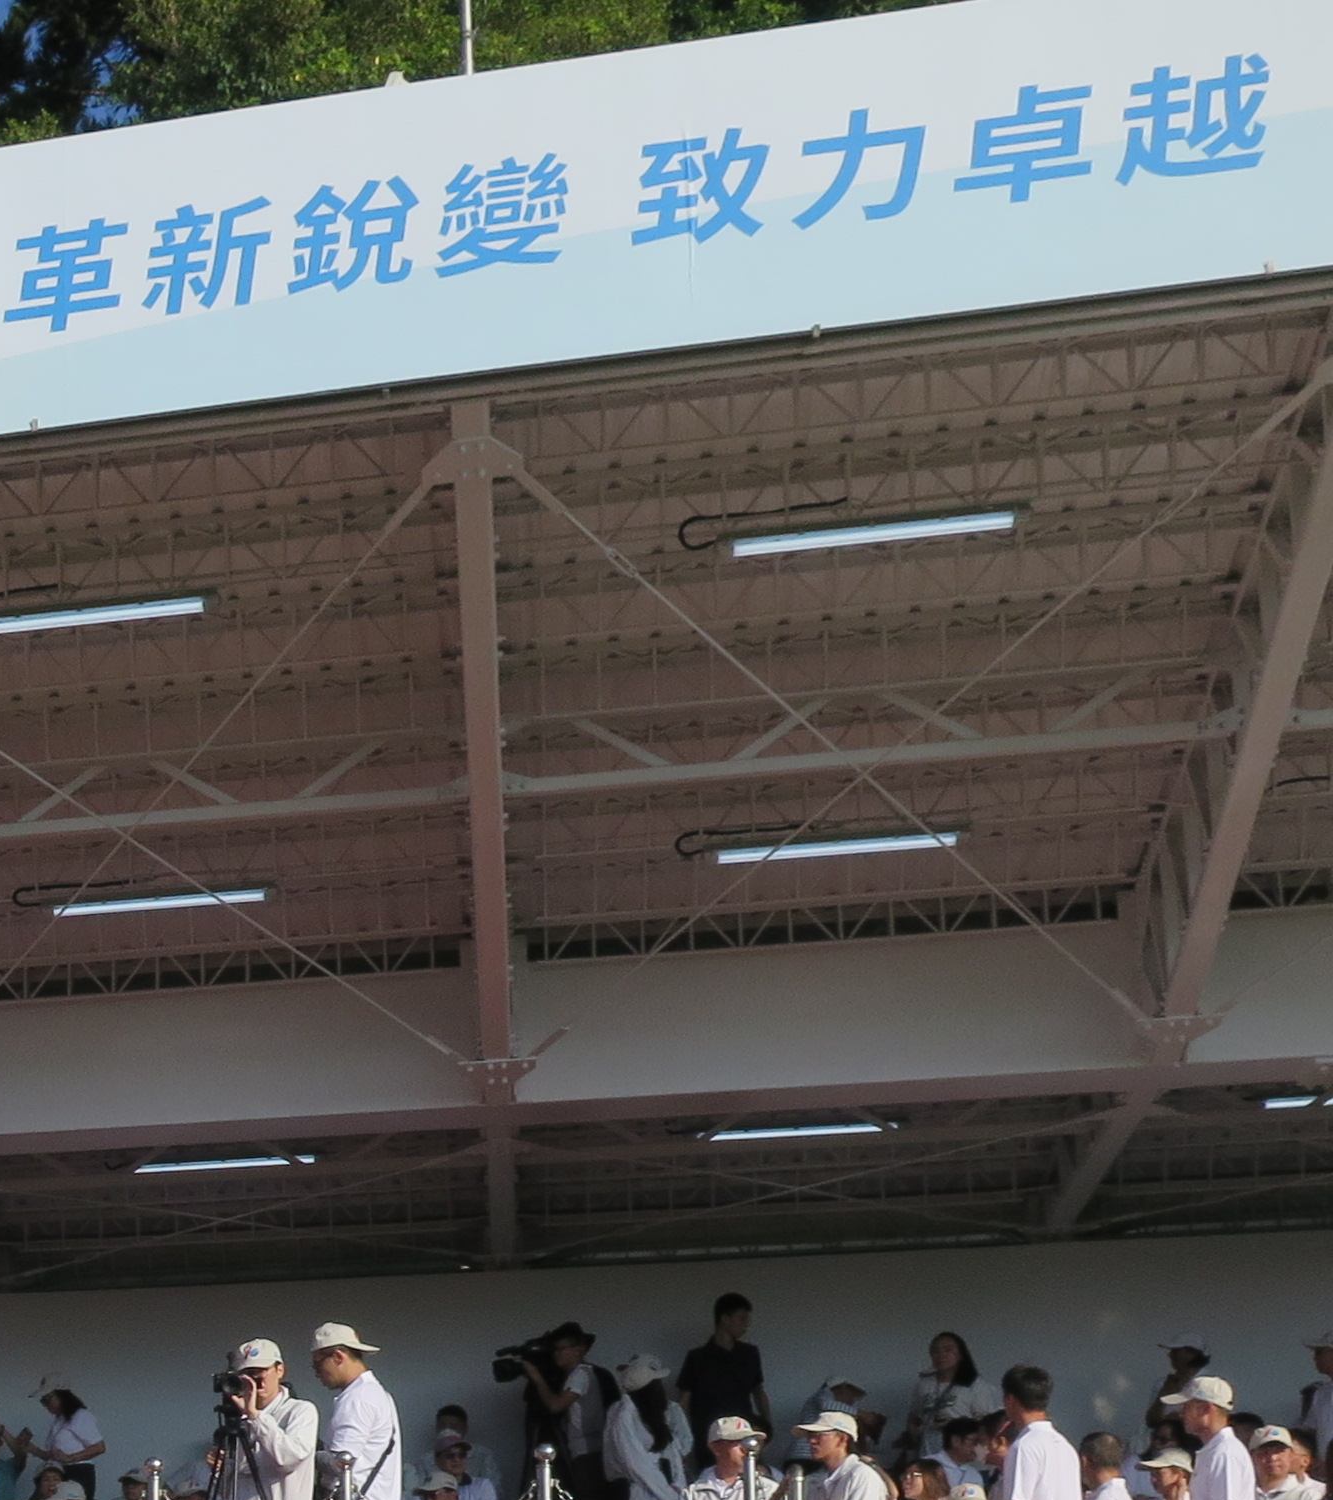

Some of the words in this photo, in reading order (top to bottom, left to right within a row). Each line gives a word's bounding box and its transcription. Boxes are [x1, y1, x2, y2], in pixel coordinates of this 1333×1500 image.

[2, 152, 571, 333] 革新銳變
[630, 53, 1271, 247] 致力卓越
